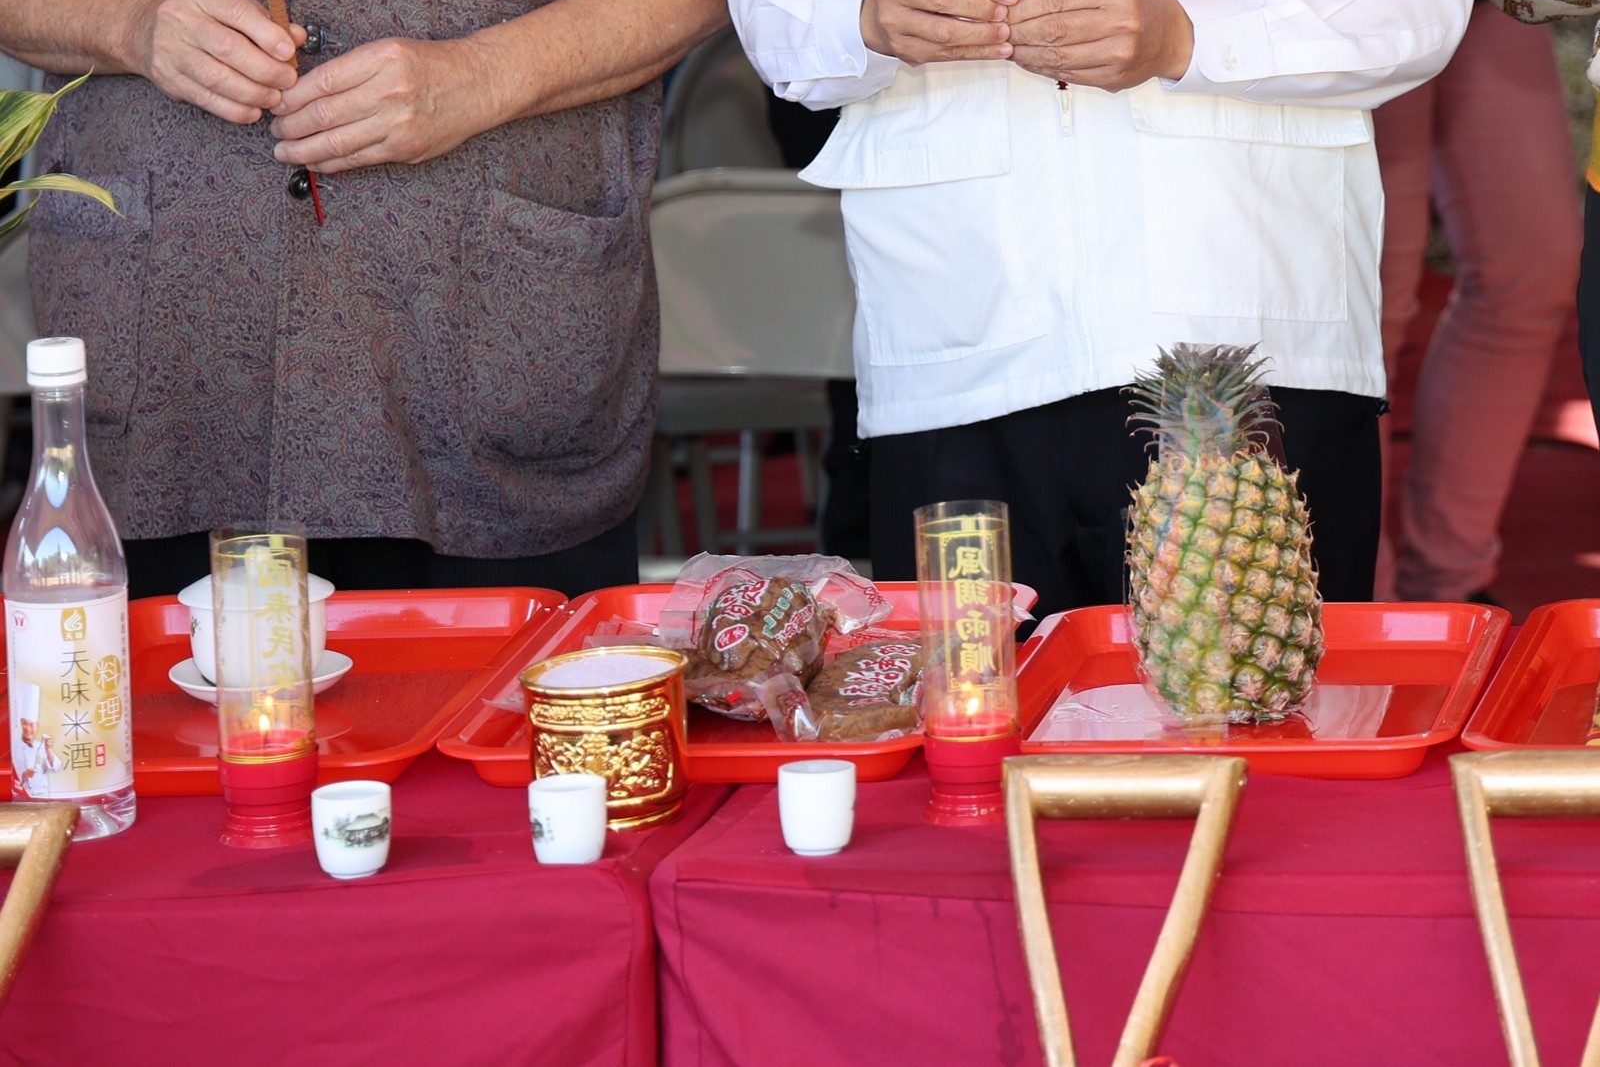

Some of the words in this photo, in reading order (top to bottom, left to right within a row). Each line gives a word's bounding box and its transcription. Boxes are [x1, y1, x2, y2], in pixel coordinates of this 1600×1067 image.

[60, 650, 93, 772] 天味米酒
[96, 657, 121, 727] 料理
